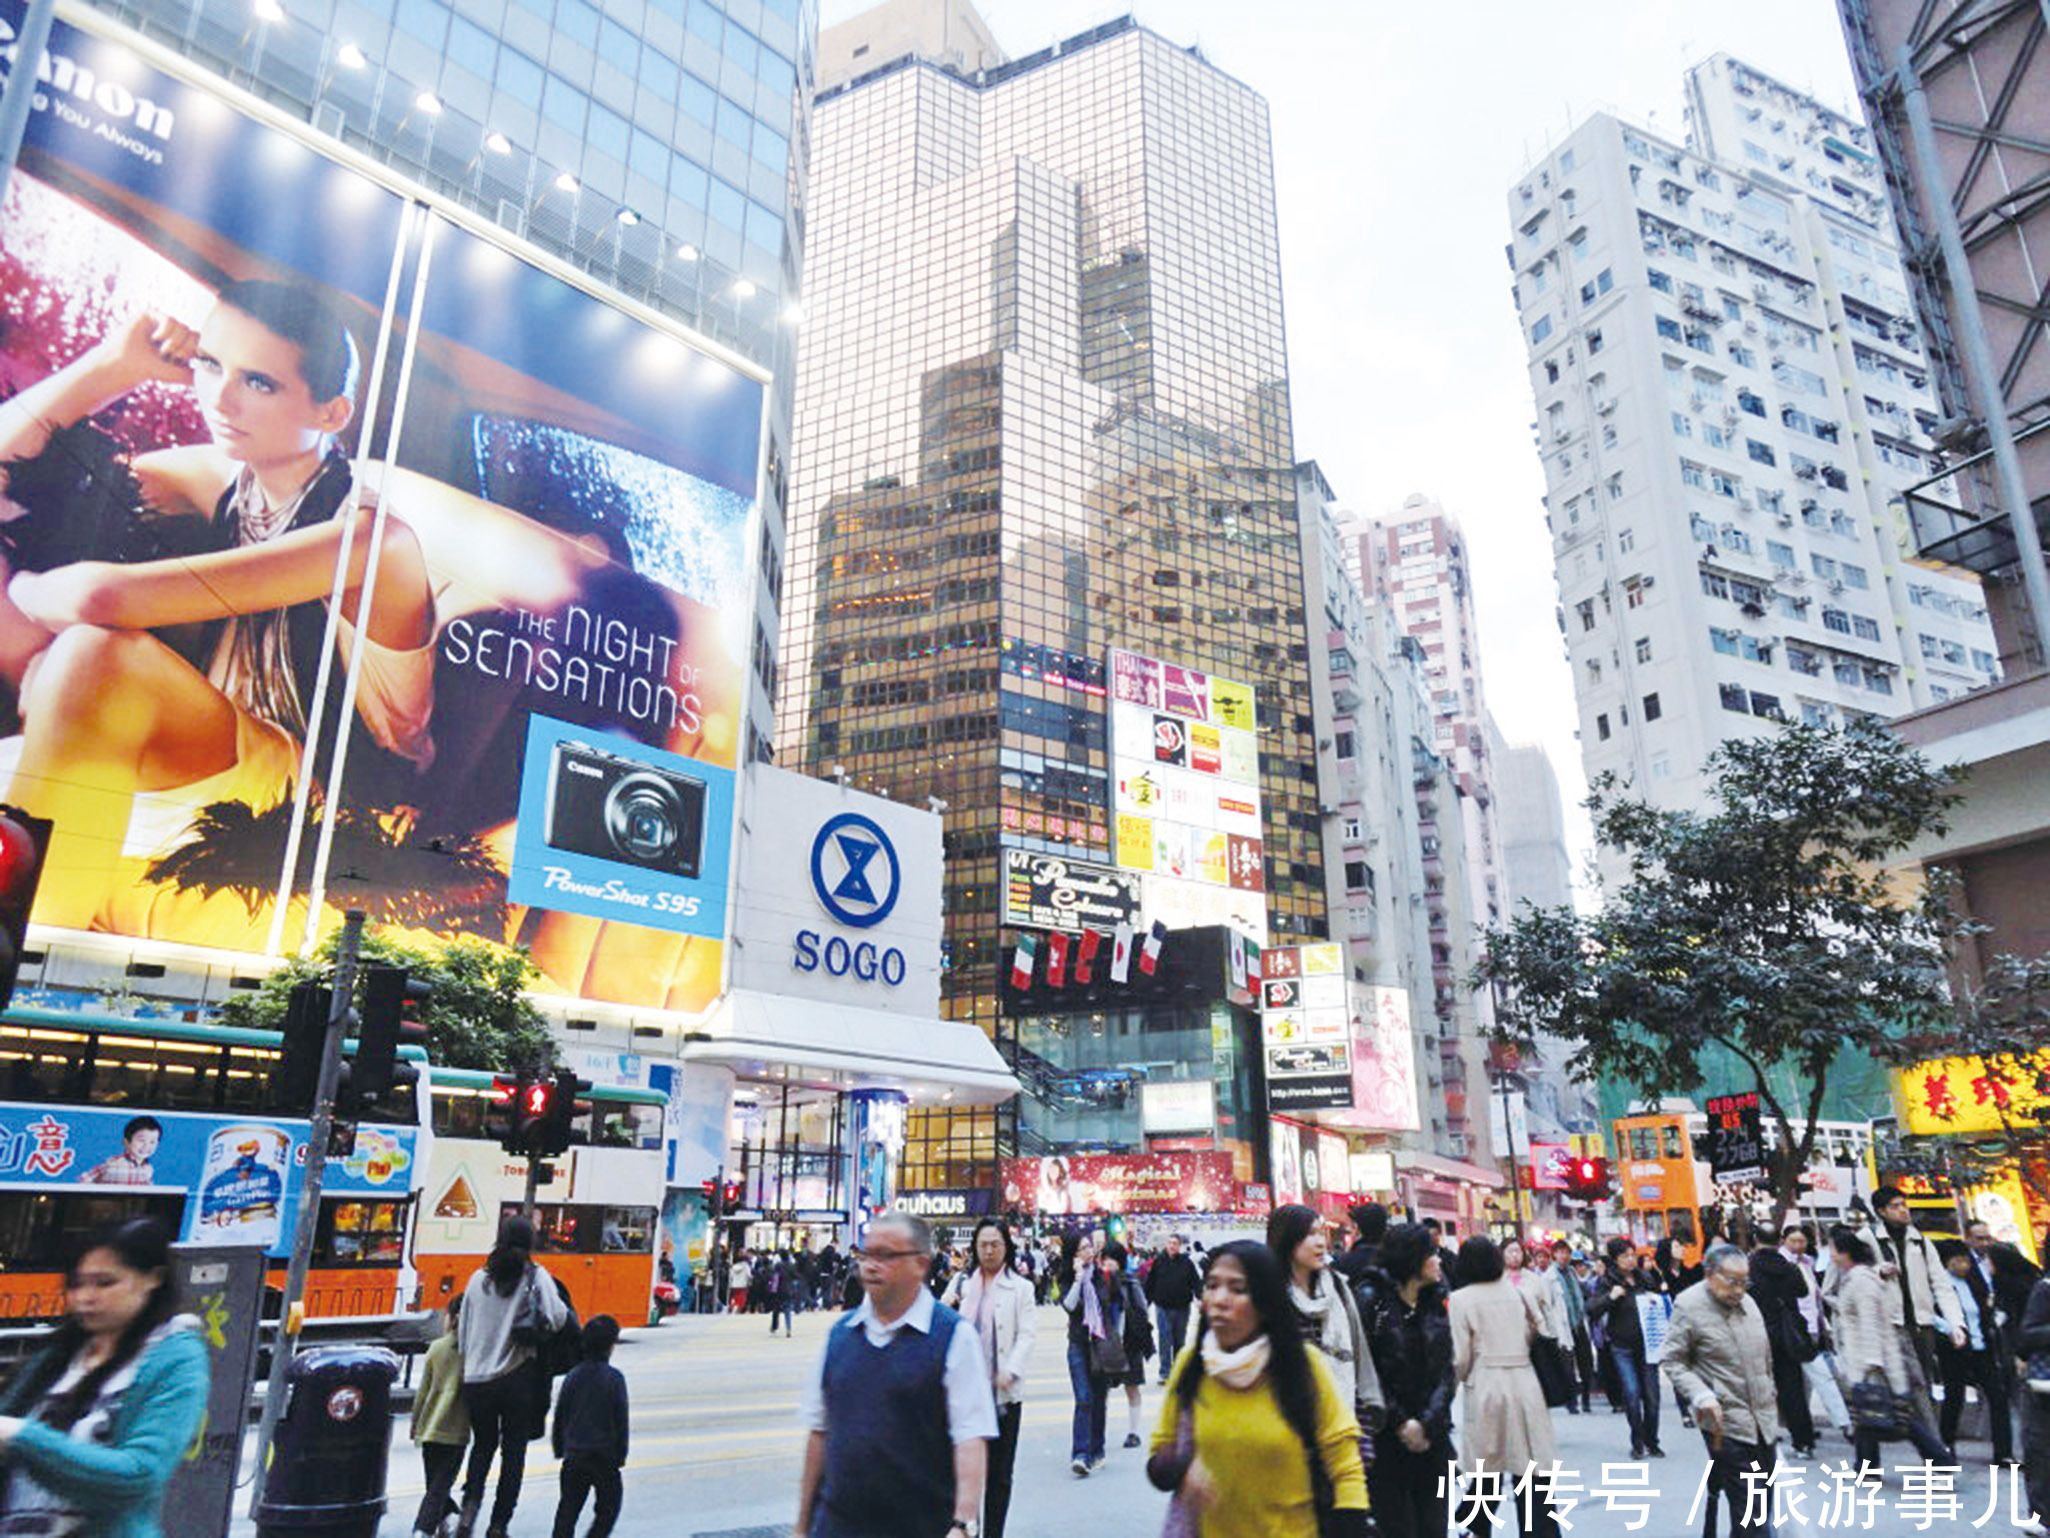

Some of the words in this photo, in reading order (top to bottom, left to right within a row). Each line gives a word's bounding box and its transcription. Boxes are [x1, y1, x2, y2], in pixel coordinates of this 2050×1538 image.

[54, 99, 91, 129] You
[94, 122, 164, 165] Always
[516, 608, 556, 641] THE
[680, 664, 700, 684] OF
[566, 760, 603, 779] Canon
[543, 866, 648, 907] PowerShot
[652, 892, 702, 916] S95
[794, 929, 906, 986] SOGO
[893, 1192, 966, 1214] auhaus
